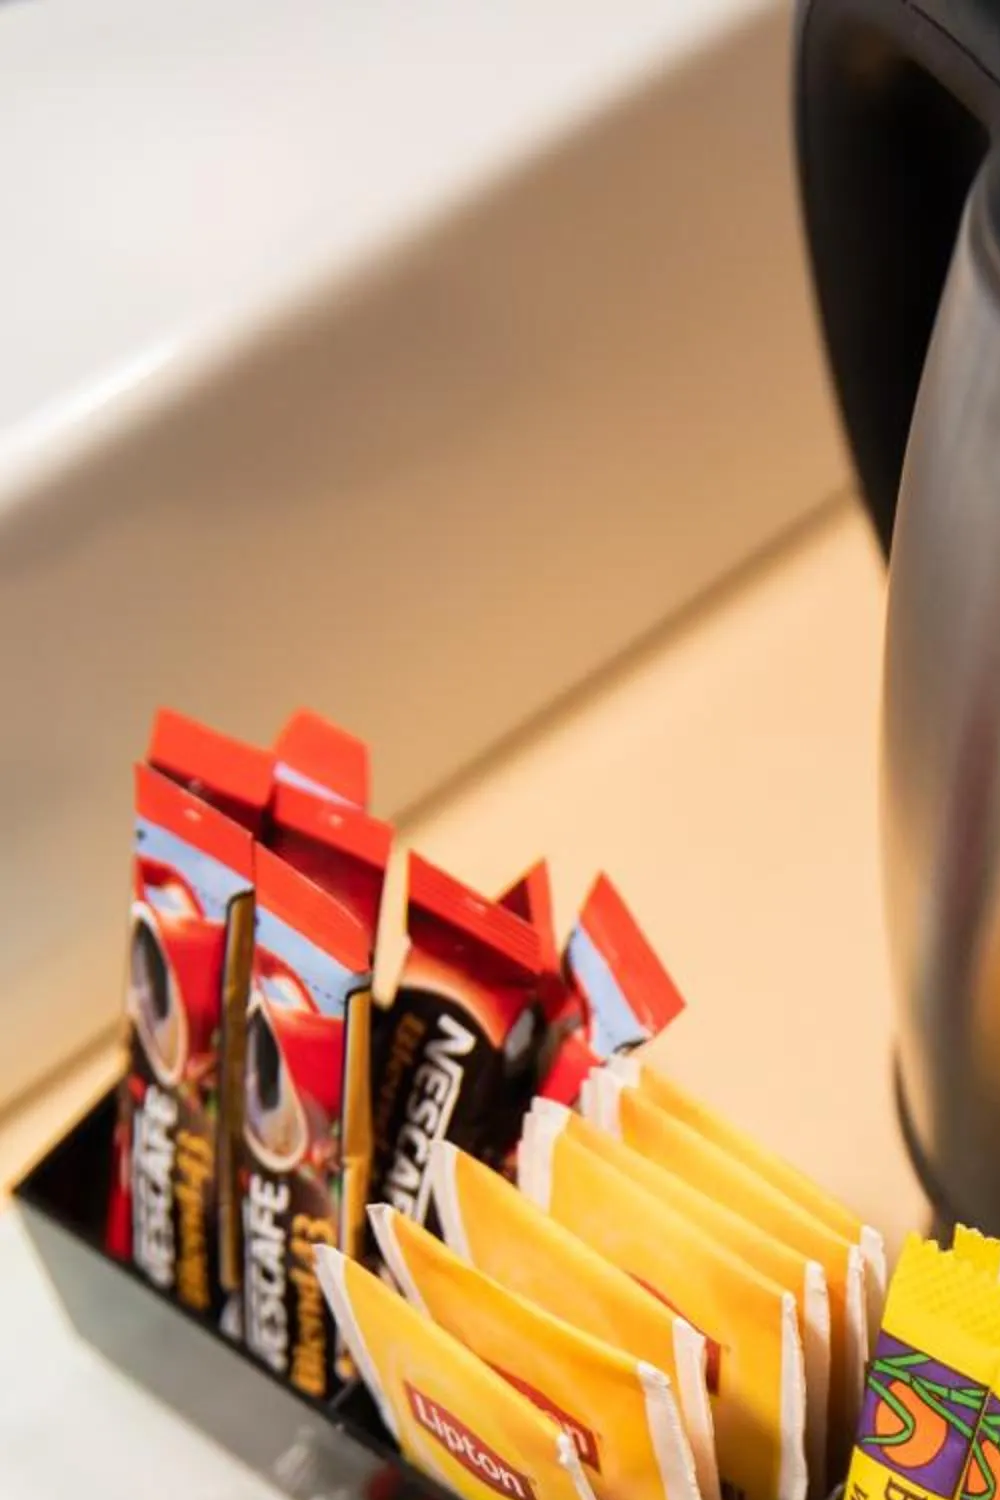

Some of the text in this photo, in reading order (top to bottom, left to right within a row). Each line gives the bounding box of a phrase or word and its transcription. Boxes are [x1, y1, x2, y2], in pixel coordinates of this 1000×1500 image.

[133, 1084, 178, 1287] ESCAFE
[242, 1174, 290, 1372] ESCAFE
[412, 1392, 526, 1499] Lipton
